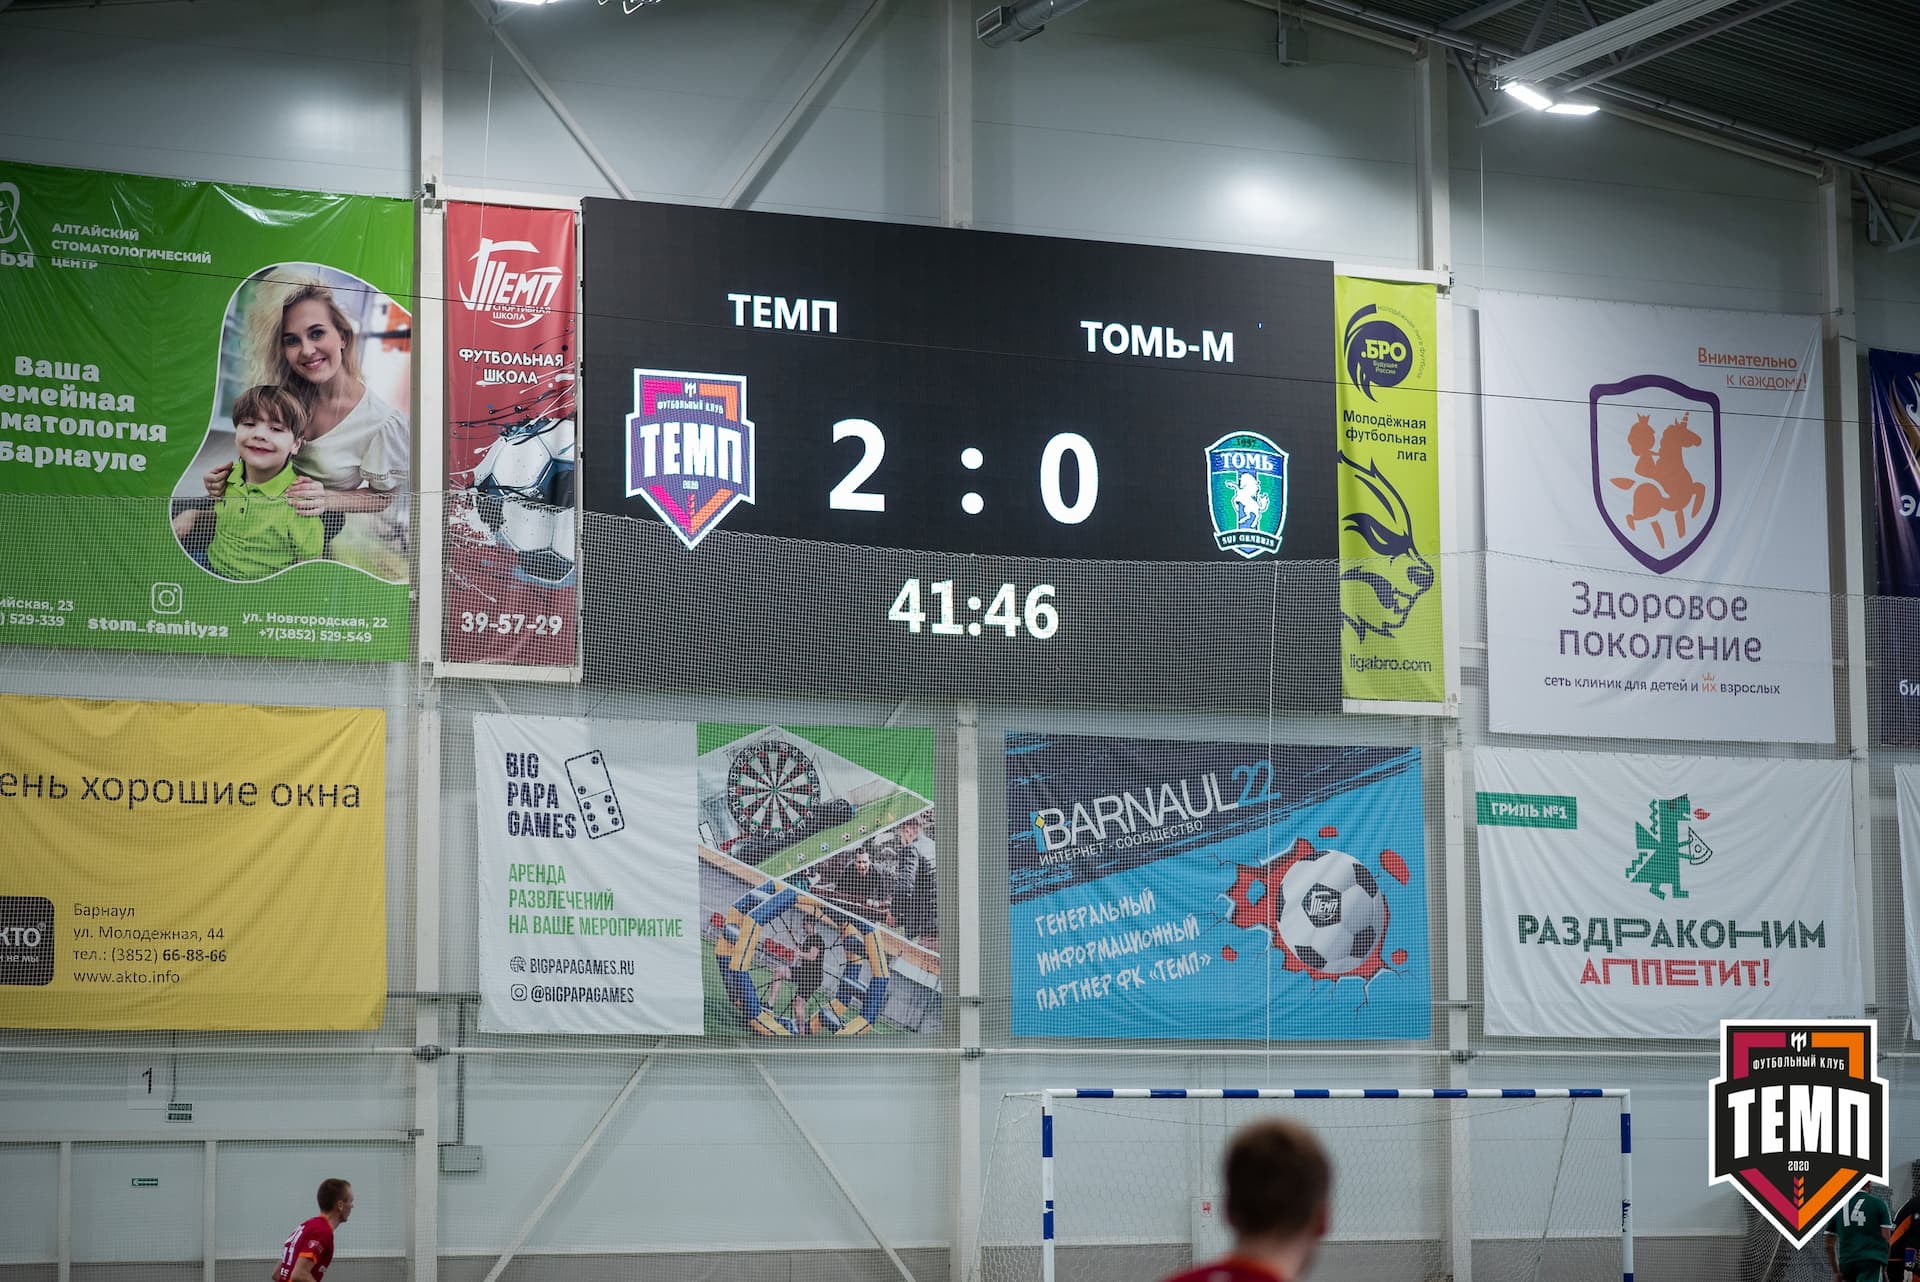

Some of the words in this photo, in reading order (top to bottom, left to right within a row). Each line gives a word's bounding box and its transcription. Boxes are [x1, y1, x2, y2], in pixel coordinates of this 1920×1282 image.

[52, 223, 140, 241] АЛТАЙСКИЙ
[51, 240, 212, 264] СТОМАТОЛОГИЧЕСКИЙ
[52, 256, 99, 270] ЦЕНТР
[493, 312, 526, 321] ШКОЛА
[727, 293, 838, 334] ТЕМП
[1080, 320, 1235, 363] ТОМЬ-М
[459, 348, 564, 367] ФУТБОЛЬНАЯ
[1698, 347, 1798, 369] Внимательно
[15, 356, 100, 382] Ваша
[483, 369, 539, 384] ШКОЛА
[1726, 374, 1735, 385] к
[0, 384, 135, 413] емейная
[1, 412, 167, 442] матология
[1343, 410, 1427, 429] Молодёжная
[1346, 427, 1427, 445] футбольная
[639, 422, 742, 485] ТЕМП
[1220, 452, 1274, 471] ТОМЬ
[1397, 450, 1427, 462] лига
[829, 418, 885, 512] 2
[1040, 432, 1099, 525] 0
[58, 600, 74, 611] 23
[888, 578, 1059, 640] 41:46
[1572, 581, 1748, 623] Здоровое
[10, 613, 65, 626] 529-339
[88, 617, 229, 638] stom_family22
[242, 612, 262, 624] ул.
[266, 612, 369, 629] Новгородская,
[373, 618, 388, 628] 22
[461, 612, 563, 636] 39-57-29
[259, 628, 316, 642] +7(3852)
[320, 631, 372, 642] 529-549
[1560, 629, 1762, 663] поколение
[1350, 654, 1432, 672] ligabro.com
[1544, 676, 1571, 687] сеть
[1575, 678, 1622, 690] клиник
[1624, 680, 1647, 692] для
[1650, 679, 1688, 692] детей
[1691, 682, 1699, 692] и
[1702, 683, 1717, 693] их
[1720, 682, 1780, 696] взрослых
[506, 752, 540, 779] BIG
[0, 772, 68, 800] ень
[81, 775, 259, 811] хорошие
[271, 781, 361, 808] окна
[507, 781, 559, 809] PAPA
[1491, 802, 1539, 818] ГРИЛЬ
[507, 811, 577, 839] GAMES
[1039, 841, 1105, 866] ИНТЕРНЕТ
[1116, 819, 1203, 850] СООБЩЕСТВО
[508, 863, 566, 885] АРЕНДА
[74, 903, 135, 918] Барнаул
[509, 888, 614, 911] РАЗВЛЕЧЕНИЙ
[1035, 887, 1156, 938] ГЕНЕРАЛЬНЫЙ
[74, 928, 93, 940] ул.
[99, 926, 202, 942] Молодежная,
[207, 927, 225, 940] 44
[509, 914, 528, 934] НА
[533, 915, 575, 935] ВАШЕ
[579, 917, 683, 937] МЕРОПРИЯТИЕ
[1518, 914, 1826, 952] РАЗДРАКОНИМ
[111, 947, 158, 962] (3852)
[162, 949, 227, 962] 66-88-66
[1036, 913, 1200, 976] ИНФОРМАЦИОННЫЙ
[74, 970, 180, 984] www.akto.info
[530, 958, 635, 975] BIGPAPAGAMES.RU
[1580, 957, 1771, 987] АППЕТИТ!
[531, 985, 635, 1003] @BIGPAPAGAMES
[1036, 974, 1112, 1011] ПАРТНЕР
[1117, 966, 1145, 991] ФК
[1843, 1199, 1866, 1227] 14
